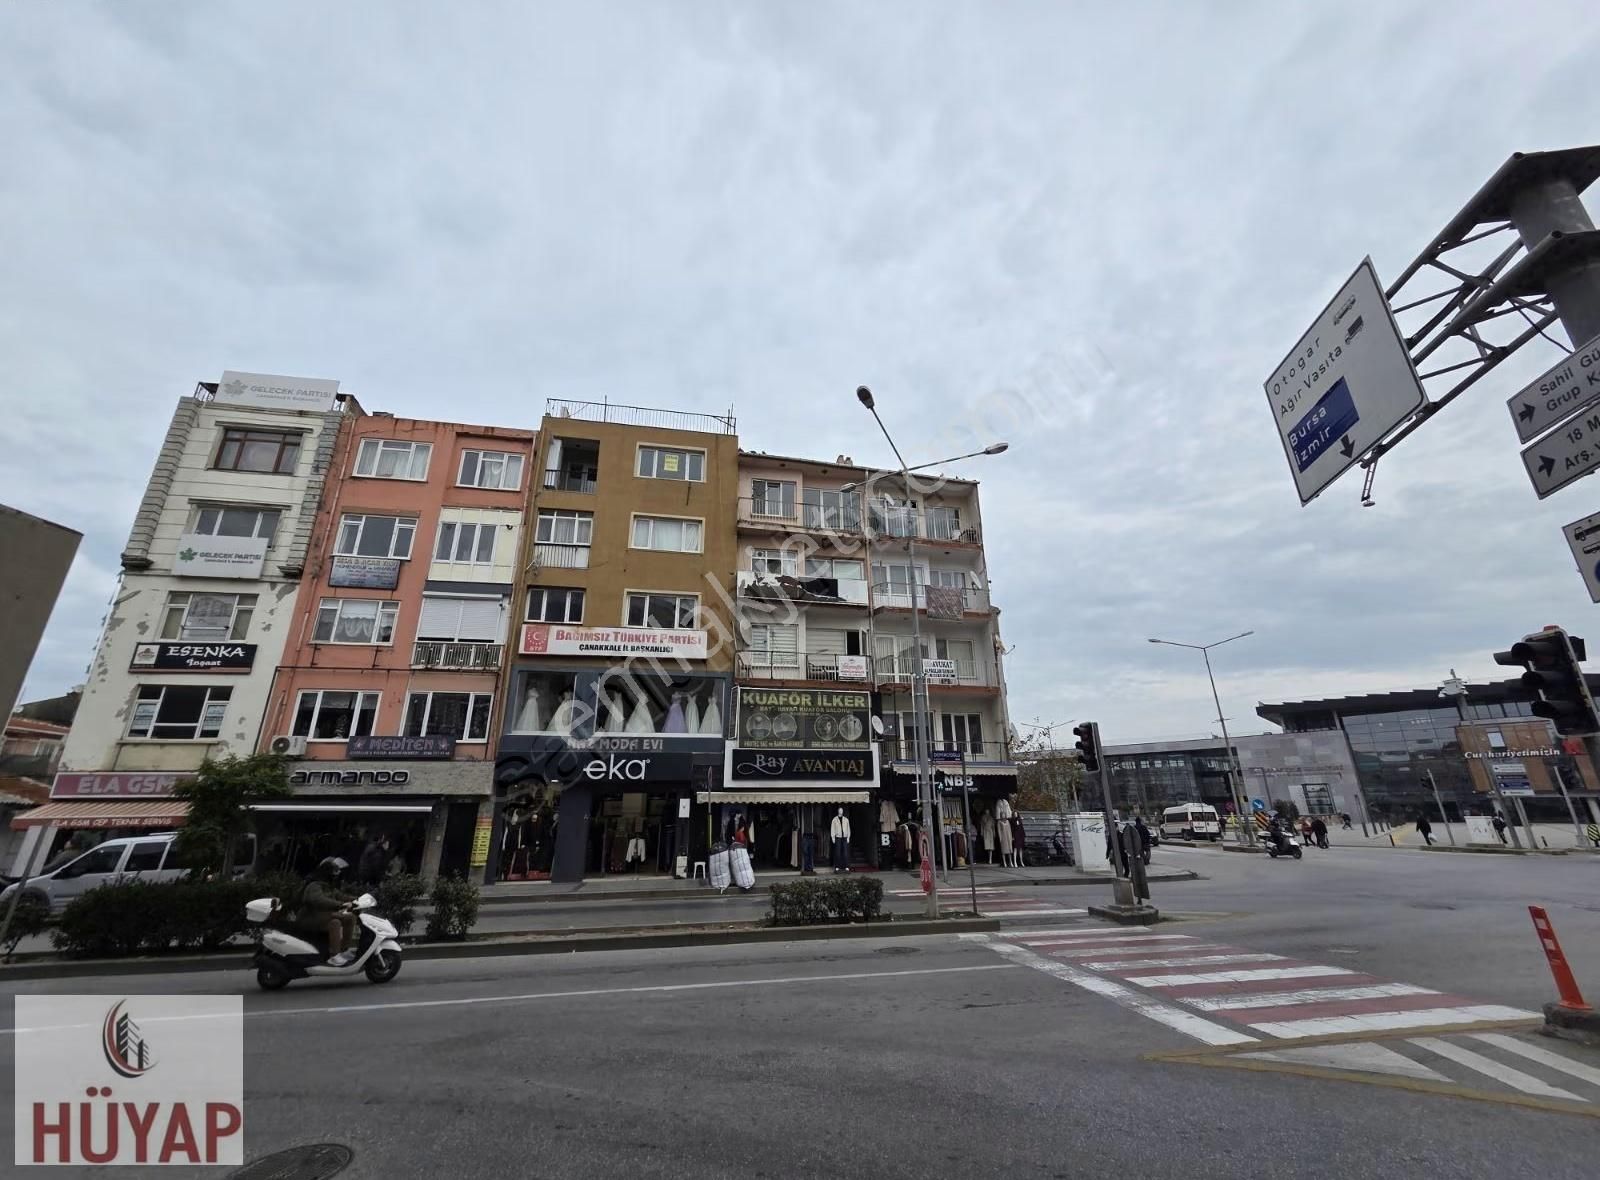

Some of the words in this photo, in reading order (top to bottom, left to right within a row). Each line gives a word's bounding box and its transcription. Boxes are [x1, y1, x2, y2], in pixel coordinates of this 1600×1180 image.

[1273, 336, 1321, 396] Otogar
[1280, 388, 1303, 418] Ağır
[1303, 345, 1343, 389] Vasıta
[1539, 367, 1574, 396] Sahil
[1546, 386, 1581, 411] Grup
[1289, 406, 1328, 447] Bursa
[1566, 428, 1583, 444] 18
[1294, 425, 1331, 465] İzmir
[166, 645, 246, 658] ESENKA
[579, 643, 622, 652] ÇANAKKALE
[742, 690, 812, 707] KUAFÖR
[817, 691, 866, 708] İLKER
[599, 738, 639, 750] MODA
[582, 753, 646, 780] eka
[741, 754, 787, 774] Bay
[791, 759, 865, 777] AVANTAJ
[76, 775, 121, 794] ELA
[127, 775, 177, 794] GSM
[944, 775, 974, 787] NBB
[51, 818, 69, 827] ELA
[70, 818, 90, 826] GSM
[93, 818, 109, 826] CEP
